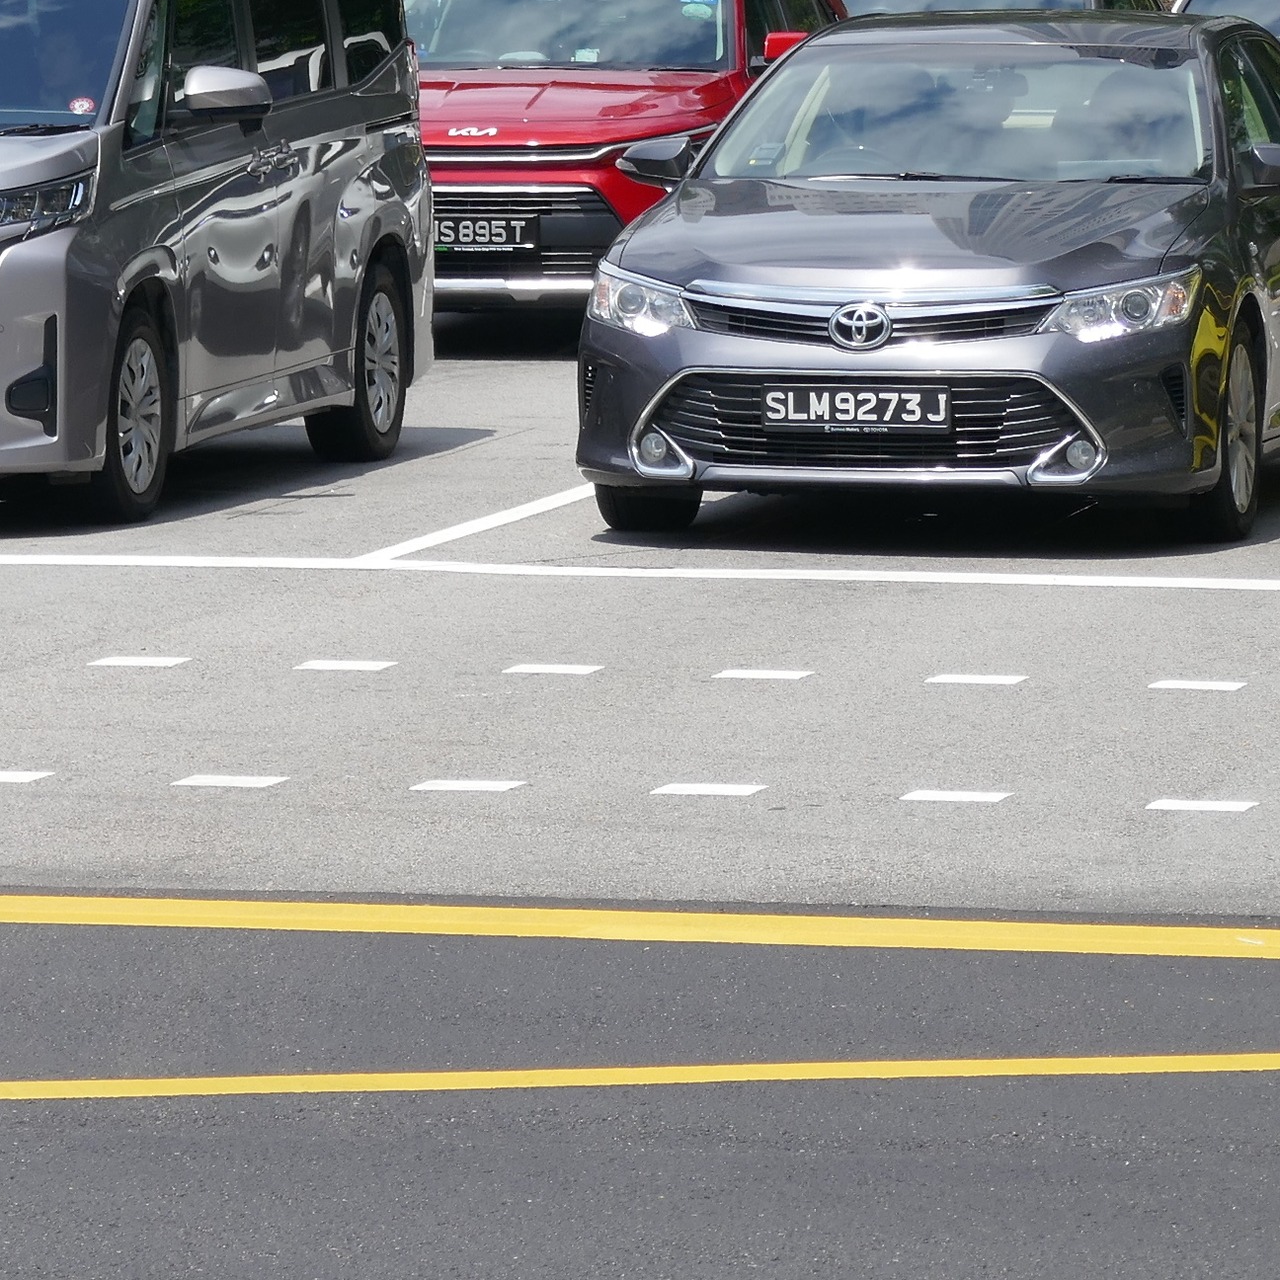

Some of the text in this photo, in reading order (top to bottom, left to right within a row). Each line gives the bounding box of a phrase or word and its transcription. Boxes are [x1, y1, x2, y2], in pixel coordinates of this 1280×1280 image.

[458, 220, 507, 243] 895
[765, 391, 947, 422] SLM 9273 J
